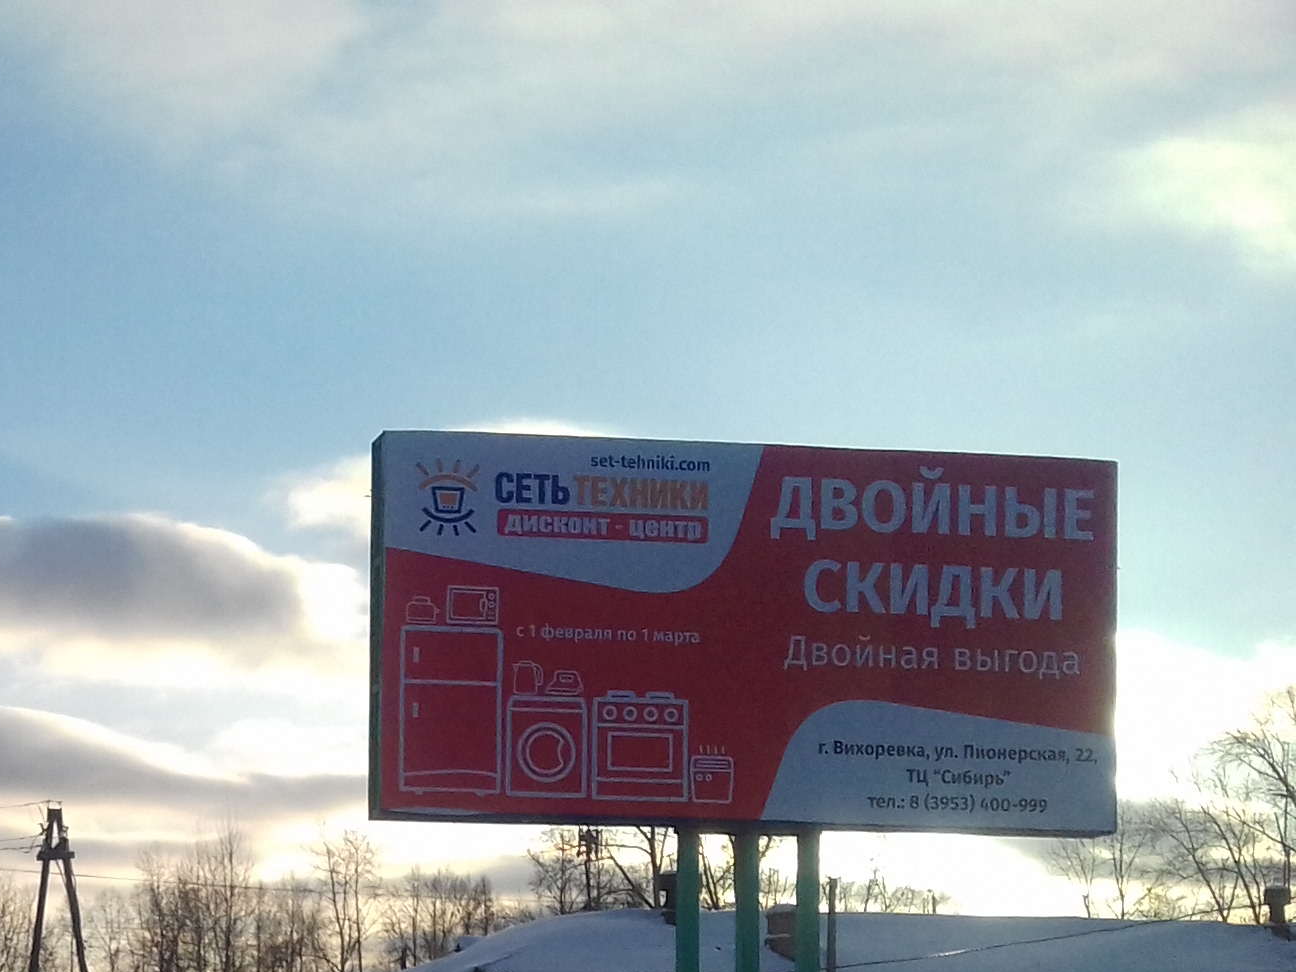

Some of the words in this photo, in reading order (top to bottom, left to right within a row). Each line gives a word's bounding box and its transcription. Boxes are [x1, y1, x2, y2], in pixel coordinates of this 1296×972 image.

[590, 454, 710, 472] set-tehniki.com
[770, 465, 1095, 541] ДВОЙНЫЕ
[803, 558, 1064, 629] СКИДКИ
[529, 625, 536, 637] 1
[541, 623, 613, 642] февраля
[617, 629, 637, 641] по
[641, 629, 649, 641] 1
[653, 631, 701, 646] марта
[784, 634, 940, 671] Двойная
[953, 648, 1081, 679] выгода
[818, 743, 829, 755] г.
[833, 740, 931, 761] Вихоревка,
[934, 747, 958, 762] ул.
[963, 745, 1071, 765] Пионерская,
[1074, 748, 1098, 764] 22,
[906, 769, 929, 787] ТЦ
[867, 796, 905, 810] тел.:
[909, 796, 919, 809] 8
[924, 793, 974, 813] (3953)
[980, 796, 1048, 814] 400-999
